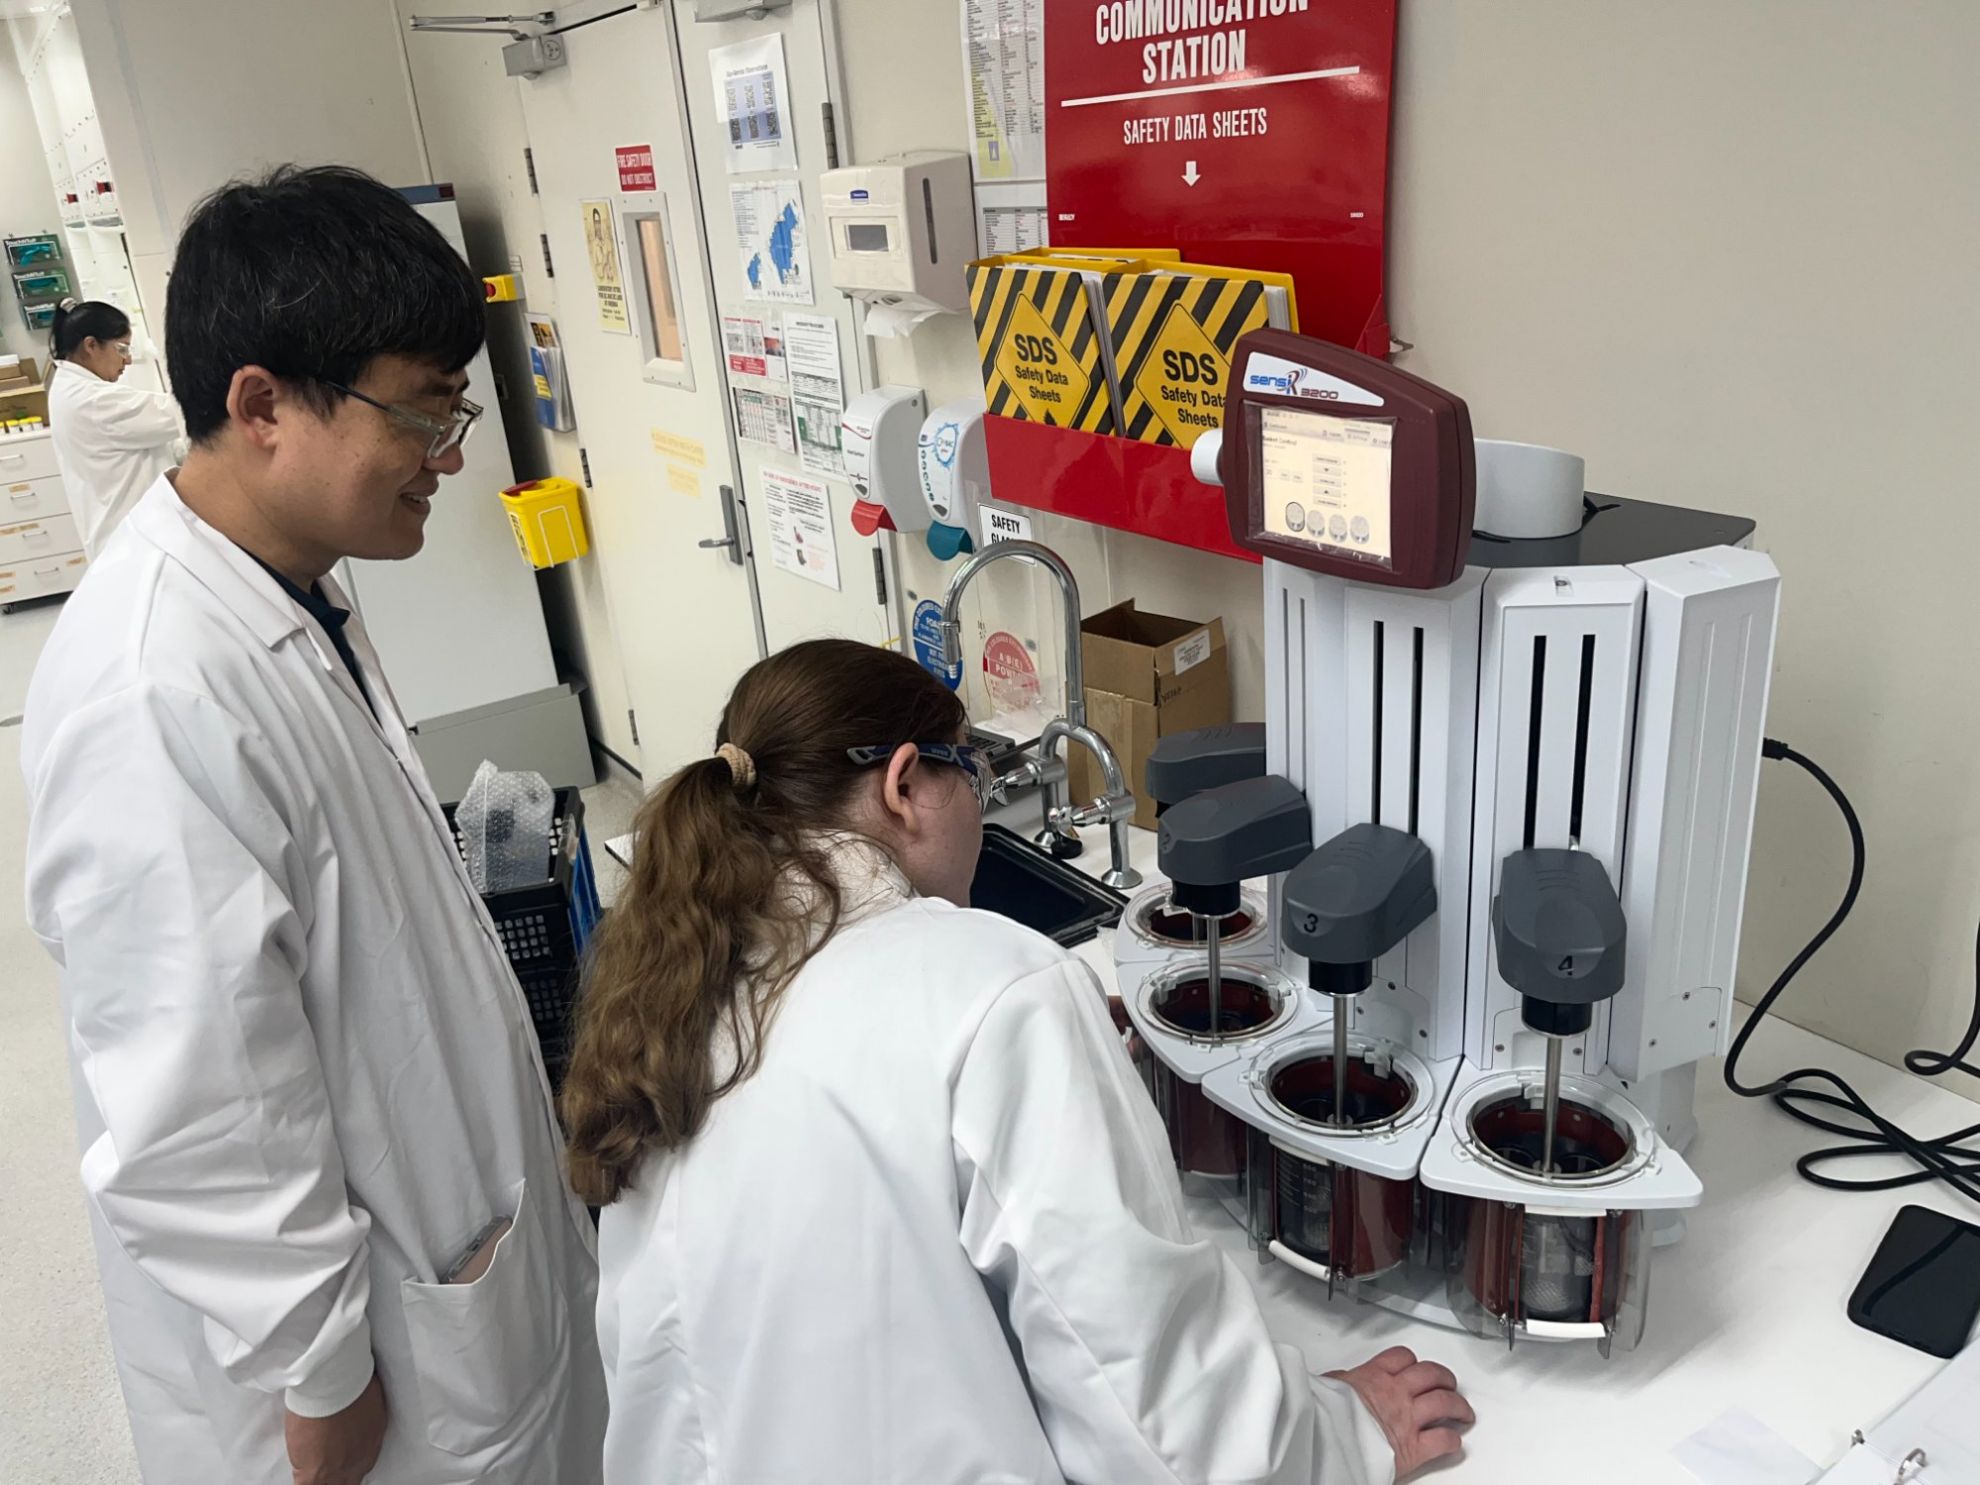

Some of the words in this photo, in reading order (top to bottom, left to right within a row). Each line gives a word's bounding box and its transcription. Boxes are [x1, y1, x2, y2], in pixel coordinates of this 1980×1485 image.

[1095, 0, 1309, 45] COMMUNICA
[1142, 29, 1246, 85] STATION
[1123, 116, 1170, 145] SAFETY
[1175, 113, 1207, 141] DATA
[1212, 107, 1268, 138] SHEETS
[1014, 333, 1058, 366] SDS
[1015, 365, 1044, 384] Safety
[1045, 369, 1069, 386] Data
[1162, 349, 1218, 386] SDS
[1029, 385, 1062, 403] Sheets
[1160, 385, 1197, 407] Safety
[1301, 388, 1339, 400] 3200
[1177, 408, 1219, 428] Sheets
[991, 514, 1020, 534] SAFETY
[1304, 913, 1318, 933] 3
[1558, 955, 1573, 976] 4
